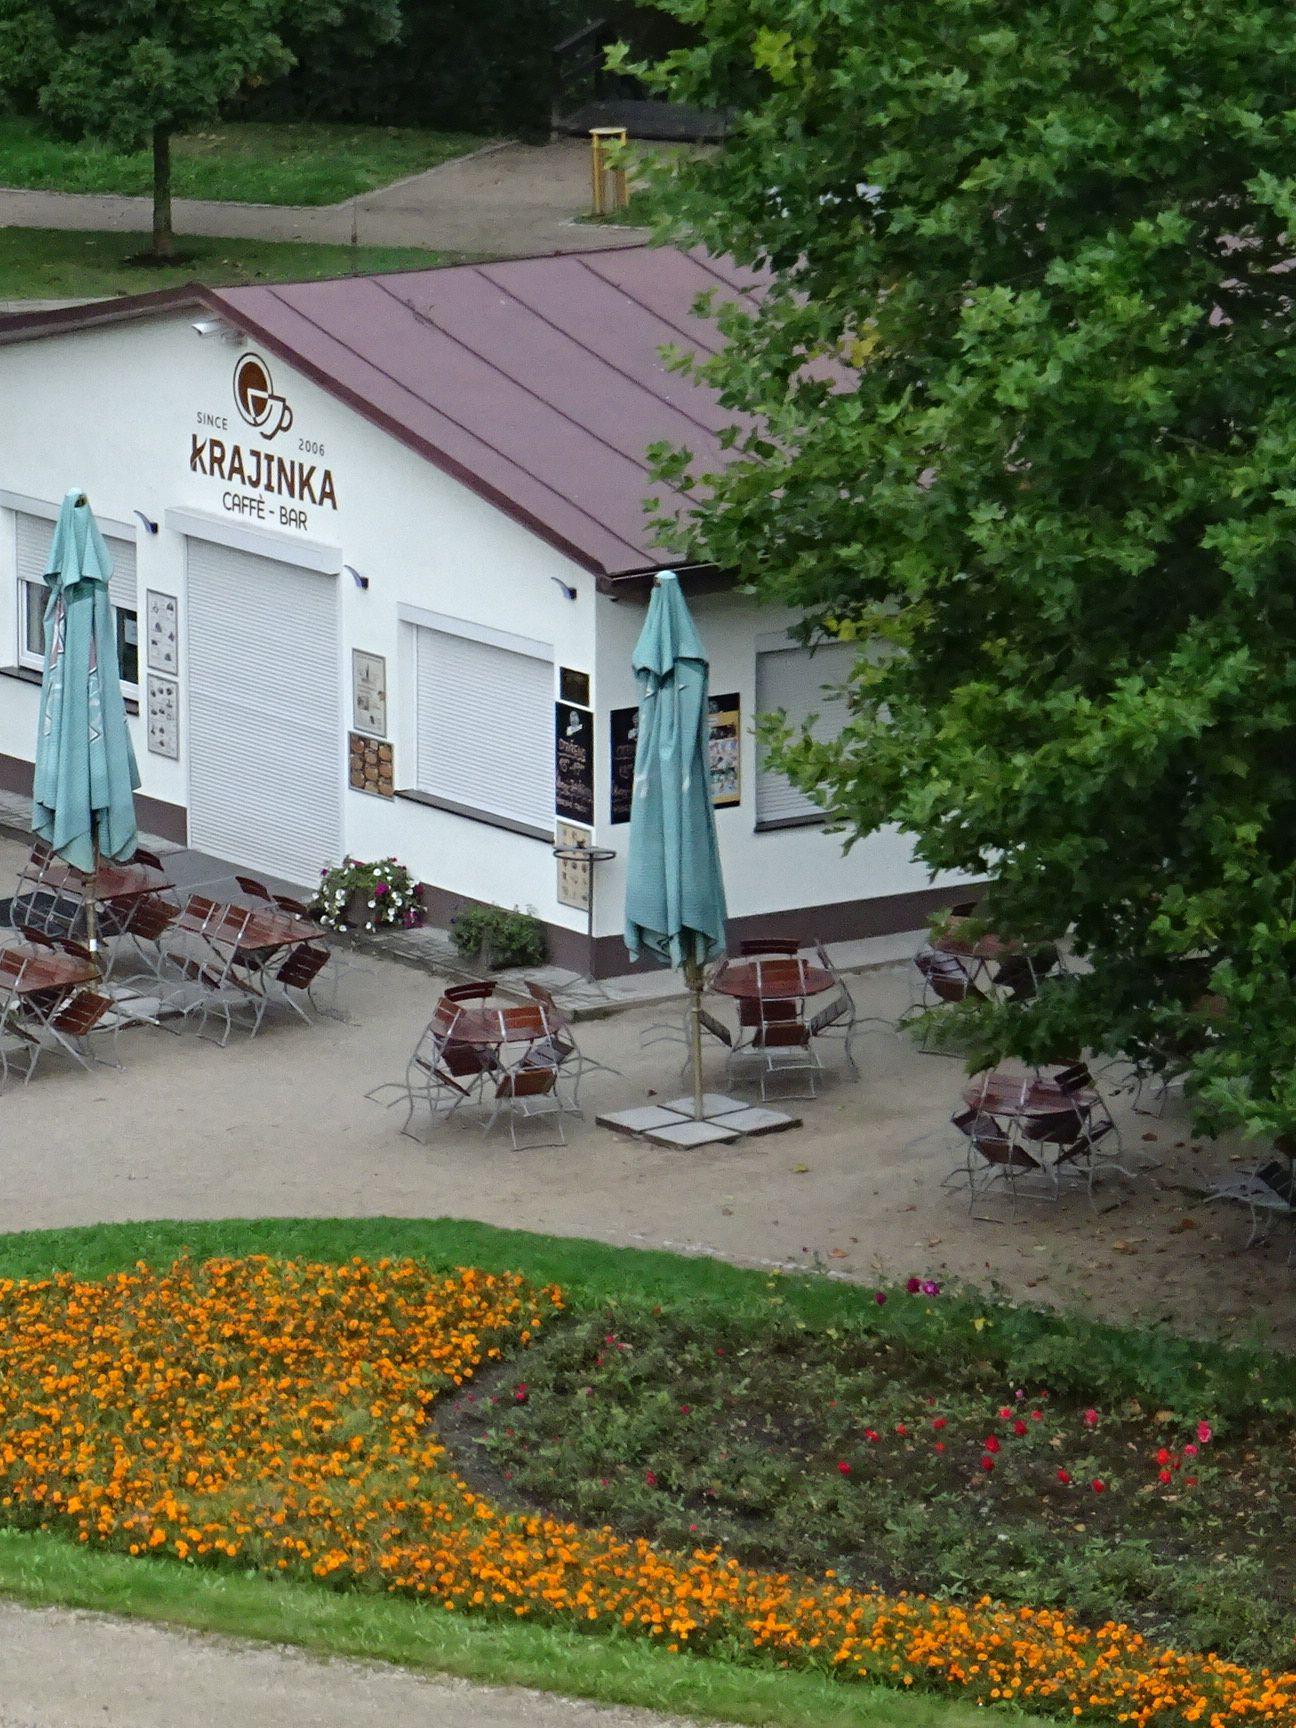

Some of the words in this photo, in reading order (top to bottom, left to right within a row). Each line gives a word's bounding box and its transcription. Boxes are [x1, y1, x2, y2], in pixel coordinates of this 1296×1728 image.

[197, 411, 228, 431] SINCE
[298, 438, 325, 457] 2006
[190, 433, 338, 511] KRAJINKA
[222, 491, 266, 520] CAFFÈ
[279, 505, 308, 531] BAR
